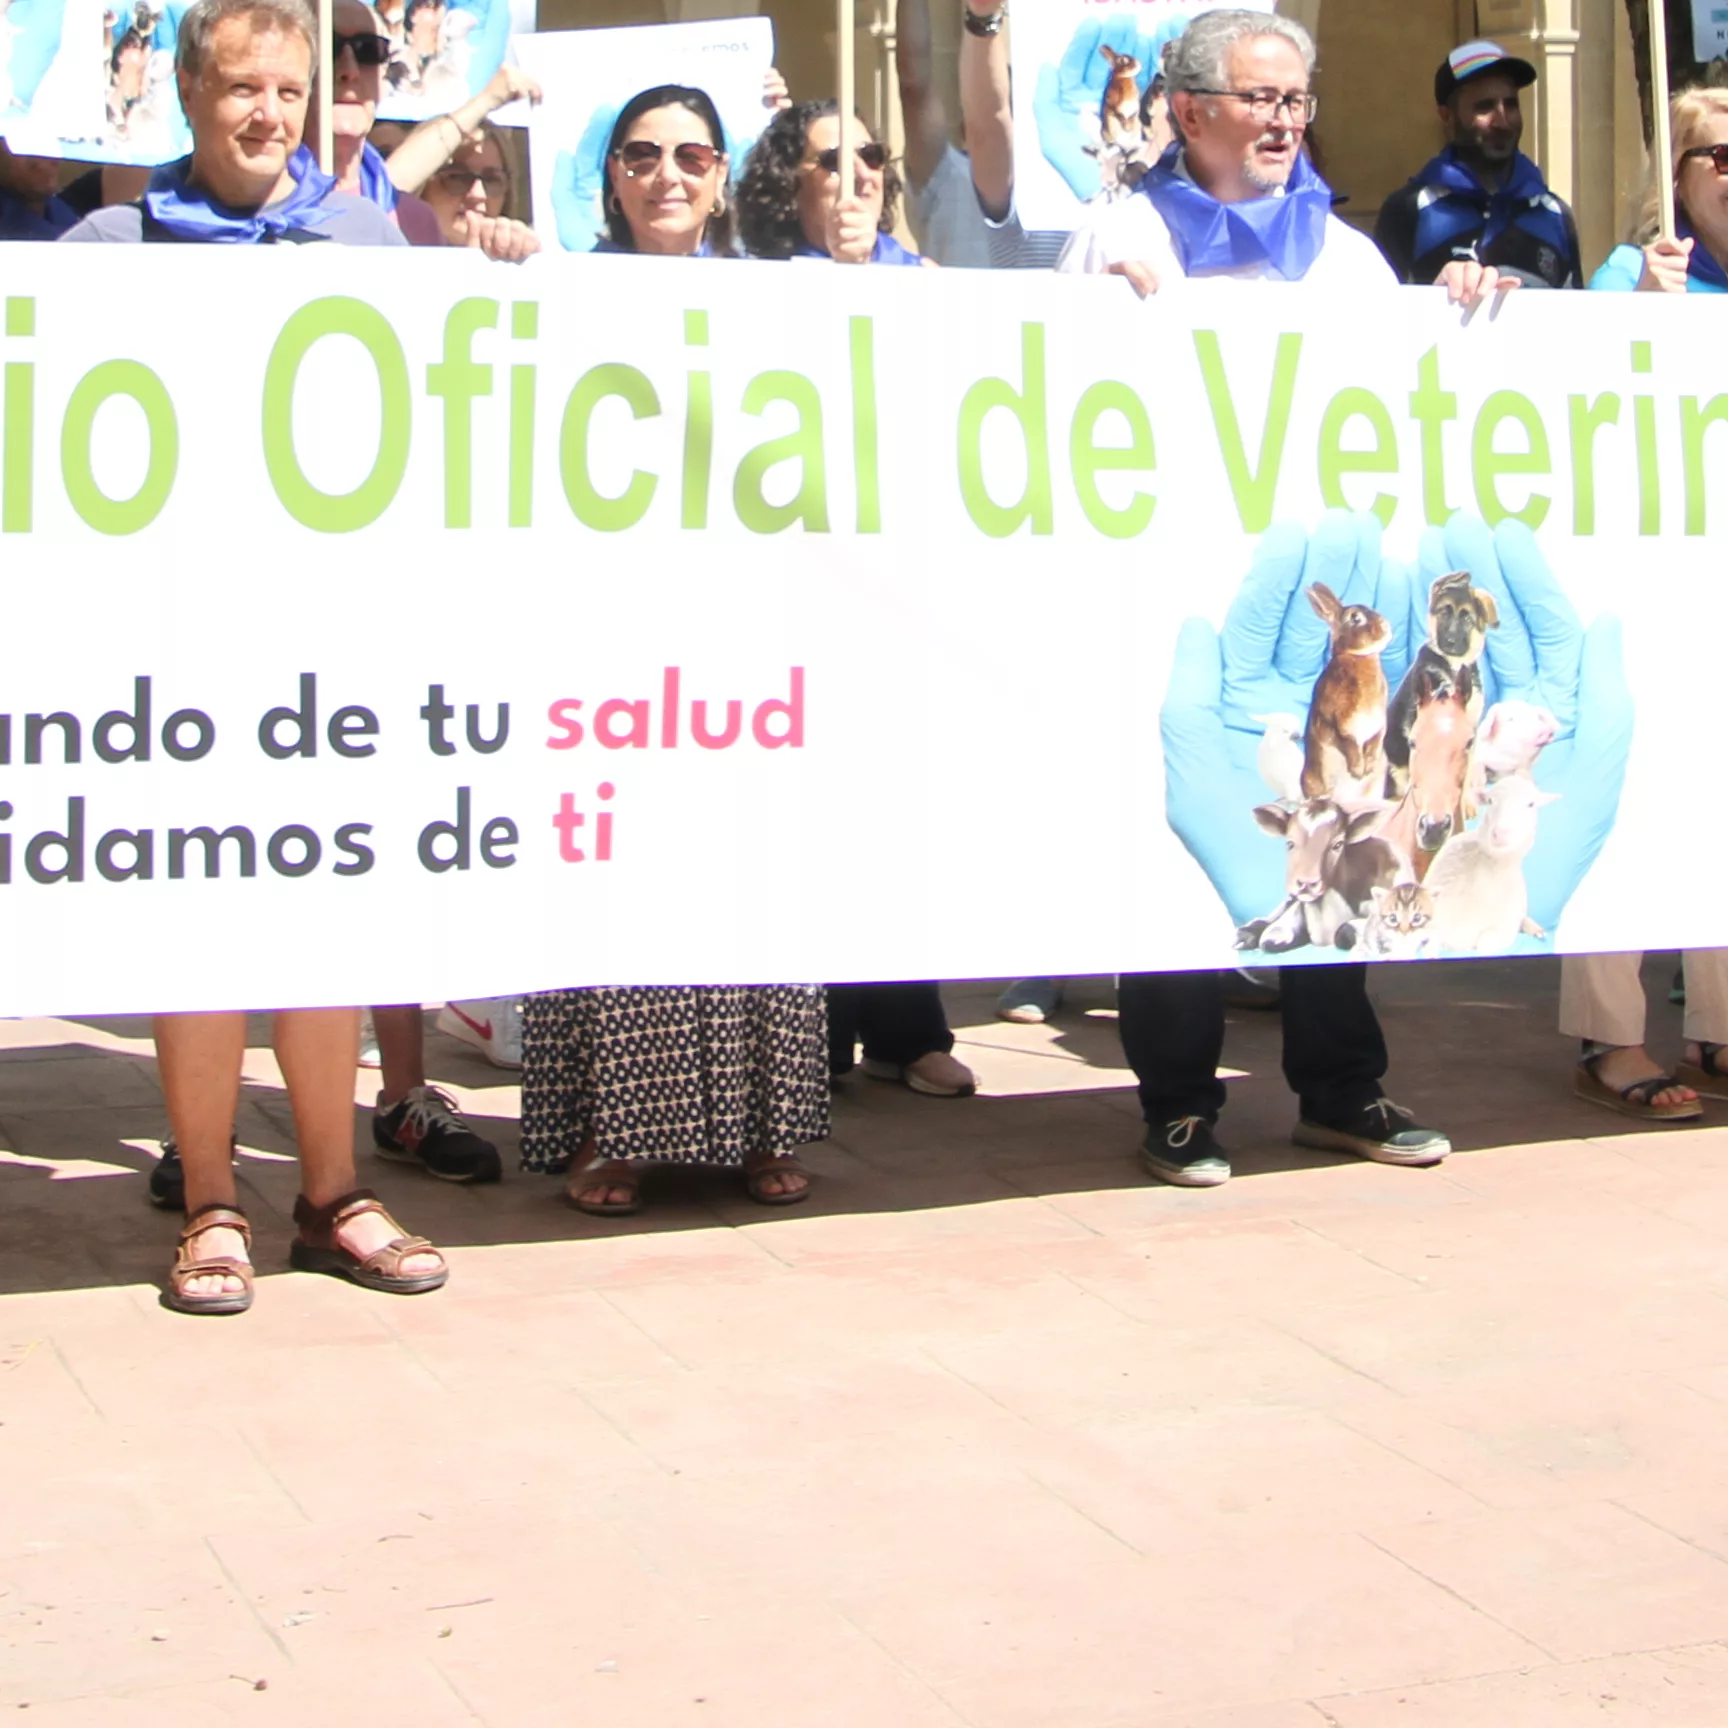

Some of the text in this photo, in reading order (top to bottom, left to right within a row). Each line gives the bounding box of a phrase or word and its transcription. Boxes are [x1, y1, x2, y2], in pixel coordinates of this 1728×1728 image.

[261, 294, 882, 534] Oficial
[956, 321, 1158, 539] de
[257, 672, 379, 758] de
[421, 683, 511, 757] tu
[544, 666, 805, 751] salud
[417, 786, 519, 872] de
[552, 781, 615, 864] ti
